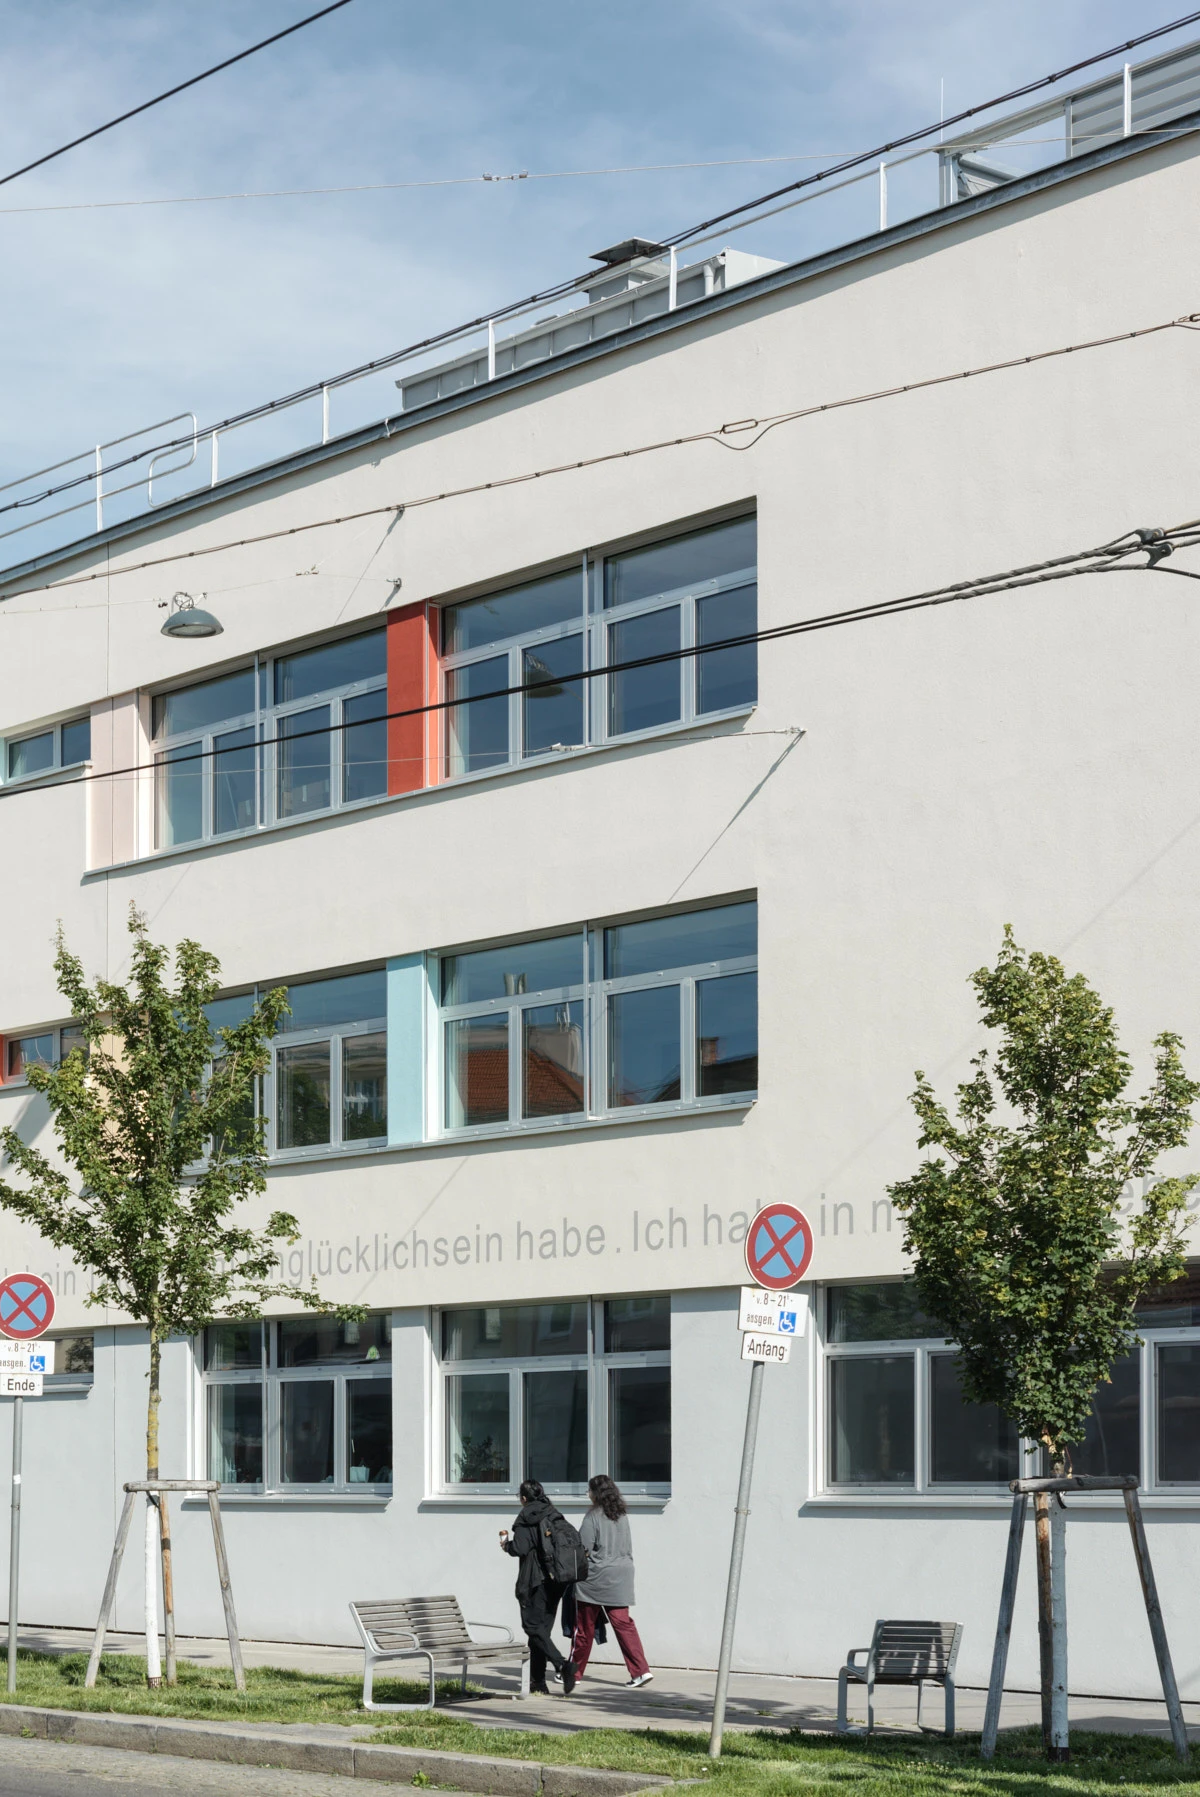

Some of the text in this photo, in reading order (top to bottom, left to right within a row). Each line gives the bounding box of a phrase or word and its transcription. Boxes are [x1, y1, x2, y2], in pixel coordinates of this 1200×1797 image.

[633, 1206, 688, 1252] Ich
[820, 1192, 855, 1237] in
[746, 1313, 776, 1327] ausgen.
[747, 1338, 785, 1361] Anfang
[7, 1378, 36, 1391] Ende
